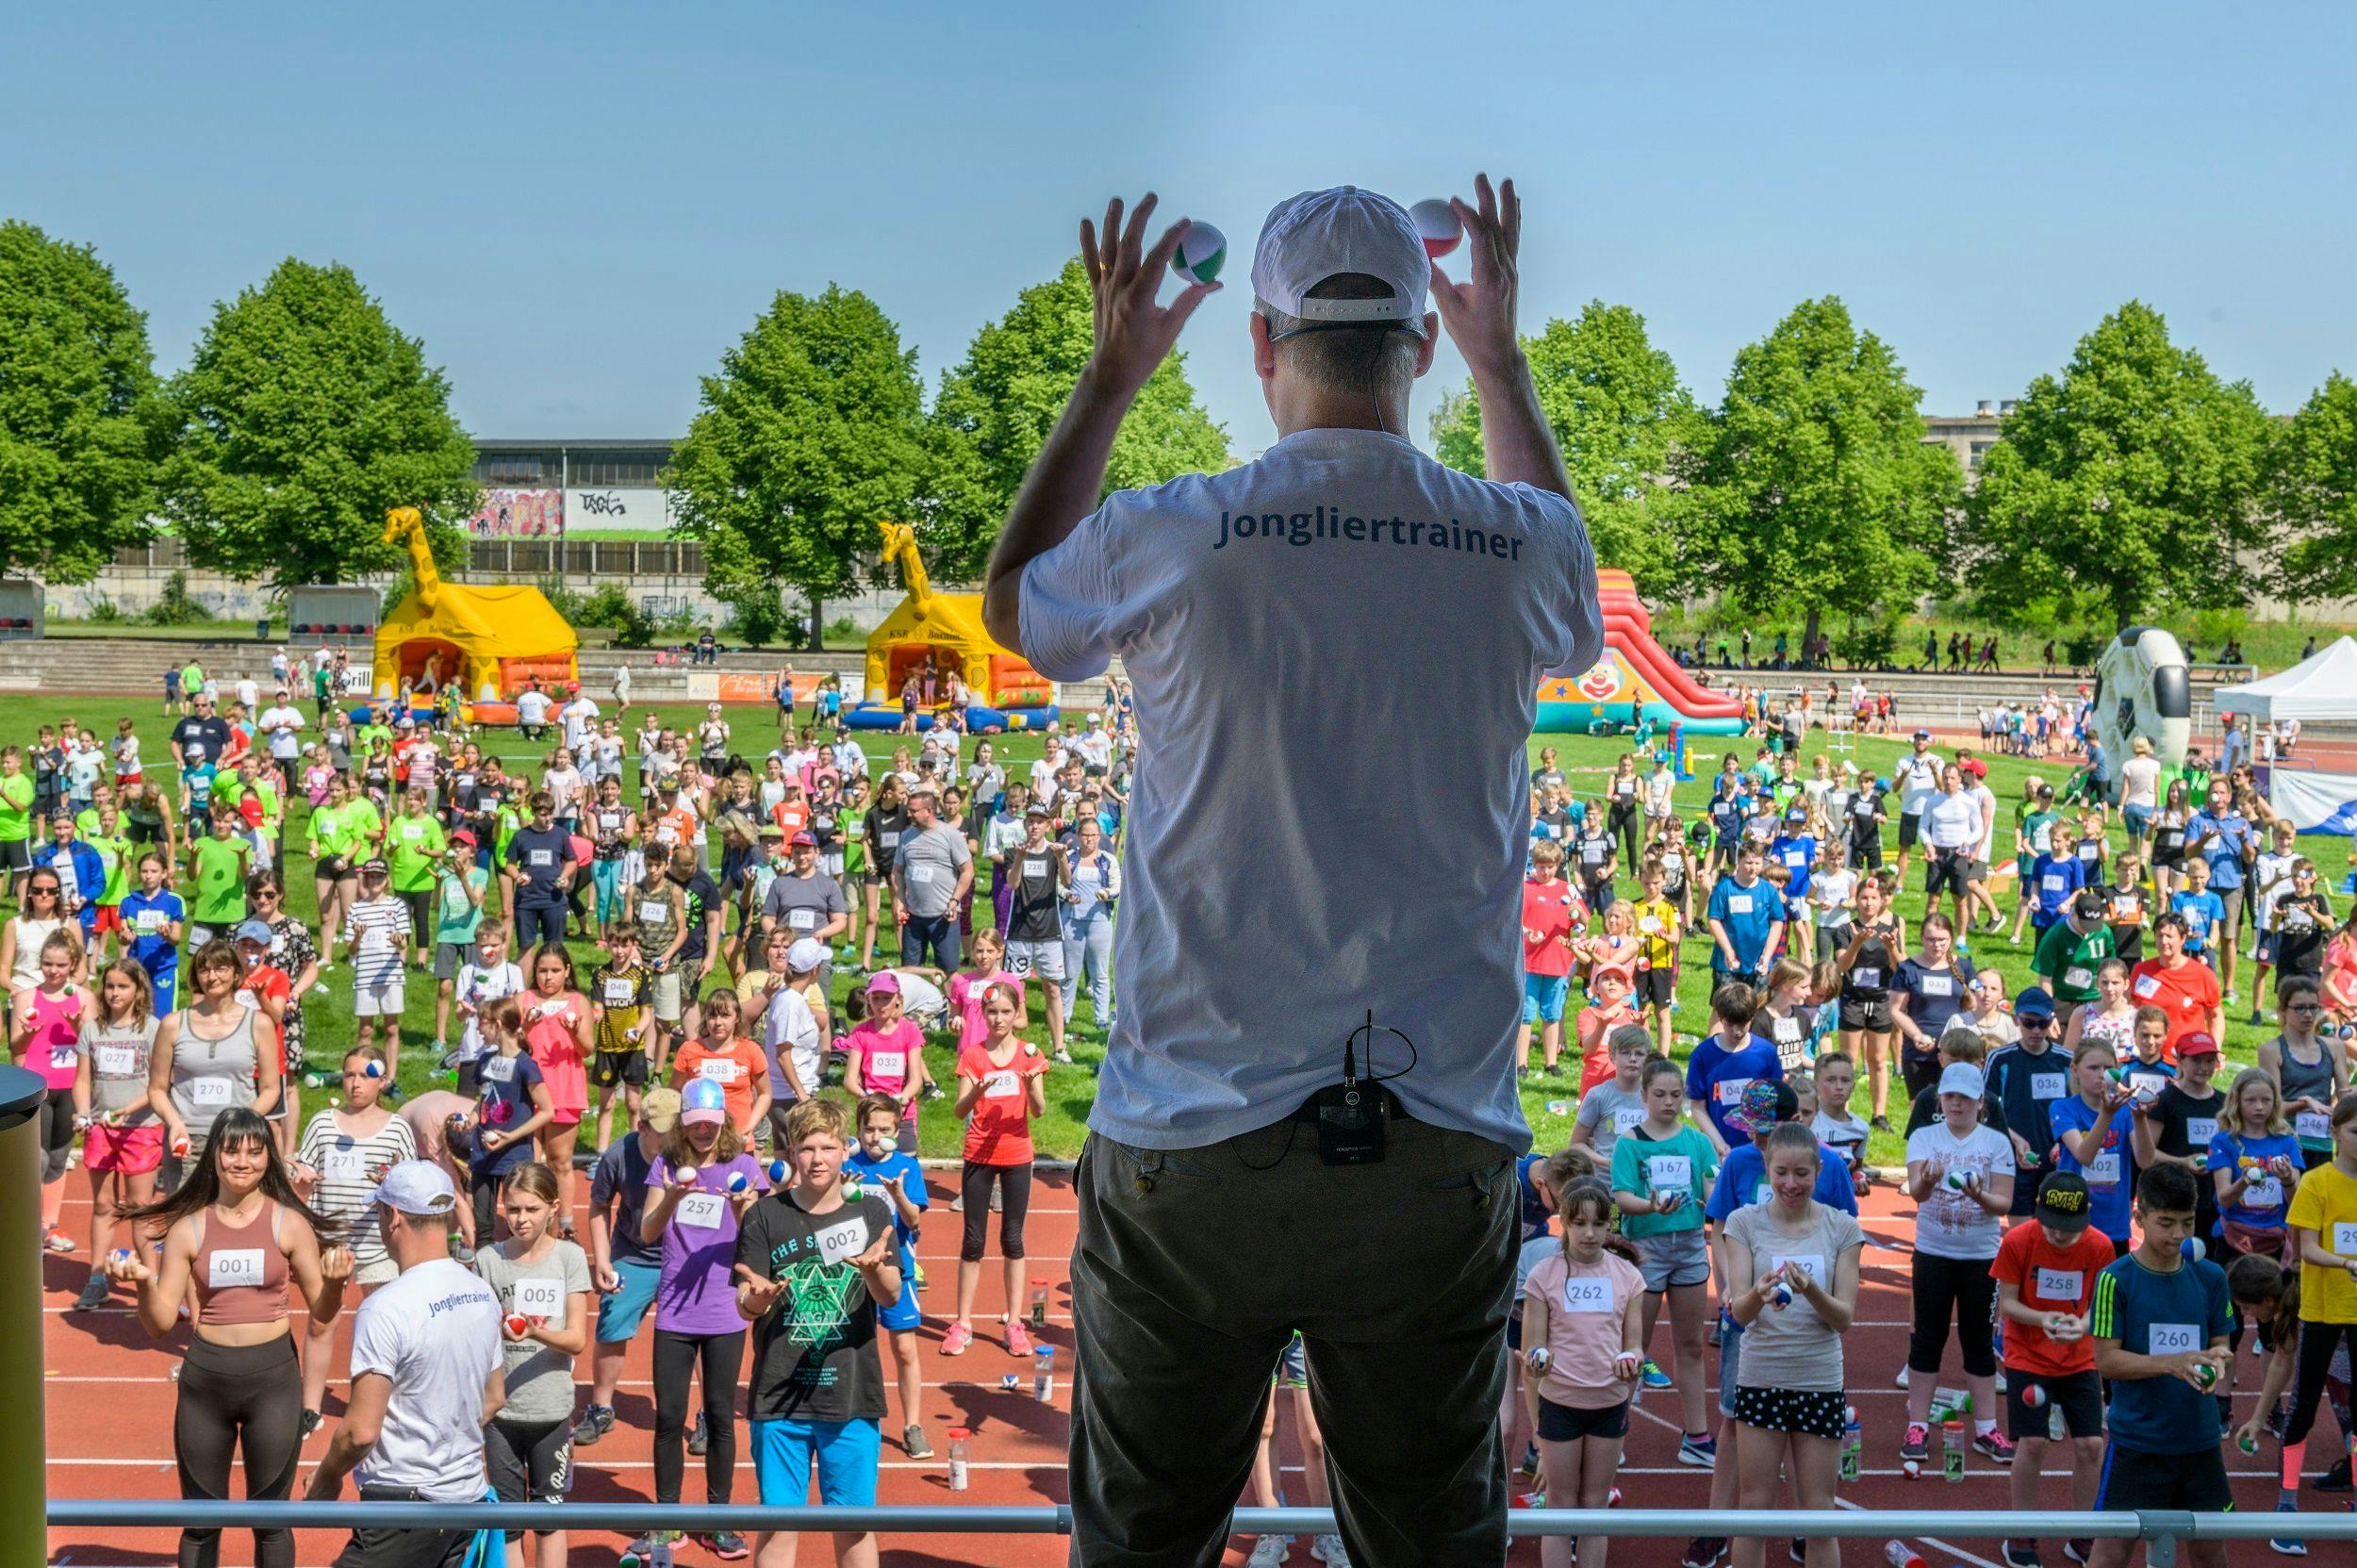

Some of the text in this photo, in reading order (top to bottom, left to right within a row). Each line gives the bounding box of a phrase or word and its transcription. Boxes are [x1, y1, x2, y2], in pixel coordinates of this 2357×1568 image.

[1213, 506, 1523, 561] Jongliertrainer
[2088, 938, 2105, 959] 11
[1008, 955, 1029, 973] 13
[106, 1052, 127, 1064] 027
[877, 1057, 898, 1067] 032
[706, 1065, 728, 1075] 038
[200, 1083, 223, 1095] 270
[2036, 1079, 2059, 1089] 036
[1620, 1114, 1642, 1125] 044
[2301, 1120, 2322, 1131] 346
[2194, 1125, 2215, 1135] 337
[332, 1156, 355, 1168] 271
[1658, 1161, 1682, 1173] 167
[685, 1199, 715, 1214] 257
[826, 1229, 859, 1251] 002
[771, 1238, 799, 1264] THE
[218, 1260, 251, 1274] 001
[2045, 1276, 2073, 1290] 258
[524, 1288, 555, 1304] 005
[1572, 1286, 1602, 1299] 262
[428, 1291, 490, 1317] Jongliertrainer
[2158, 1331, 2189, 1346] 260
